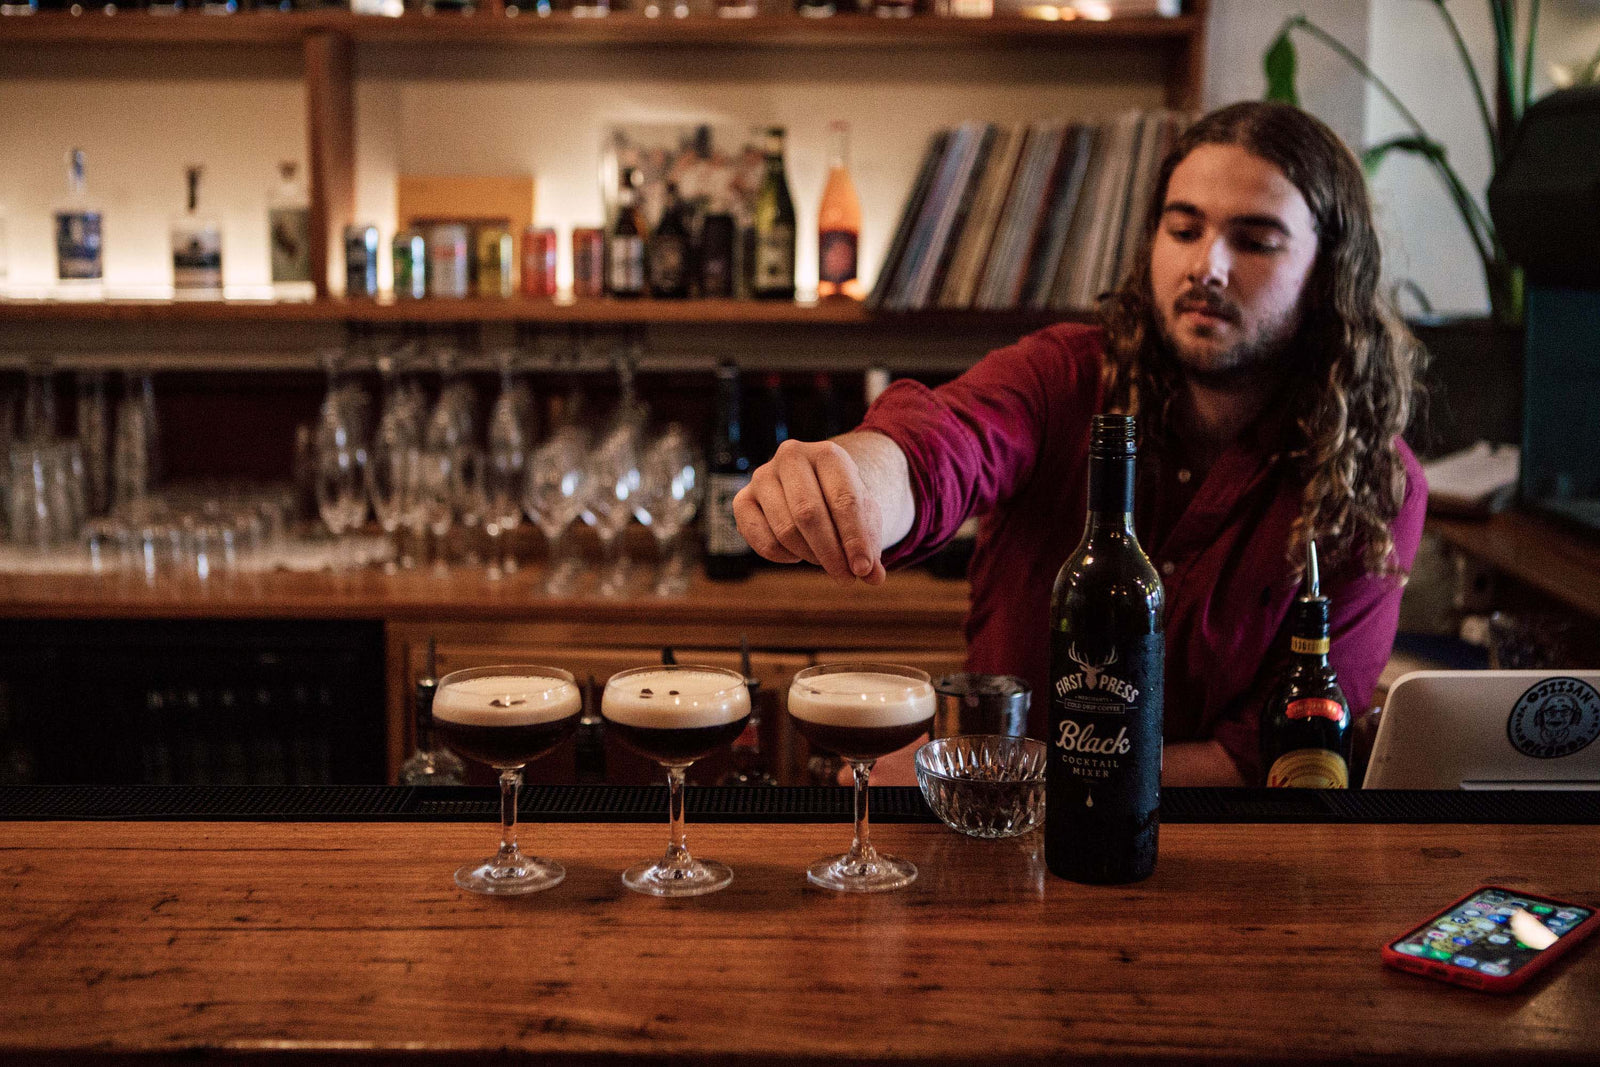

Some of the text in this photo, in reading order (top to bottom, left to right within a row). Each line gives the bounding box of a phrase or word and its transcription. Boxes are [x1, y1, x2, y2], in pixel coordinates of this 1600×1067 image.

[1056, 673, 1140, 703] FIRST PRESS
[1067, 701, 1082, 709] COLD
[1056, 719, 1131, 755] Black
[1062, 754, 1119, 768] COCKTAIL
[1072, 766, 1110, 778] MIXER
